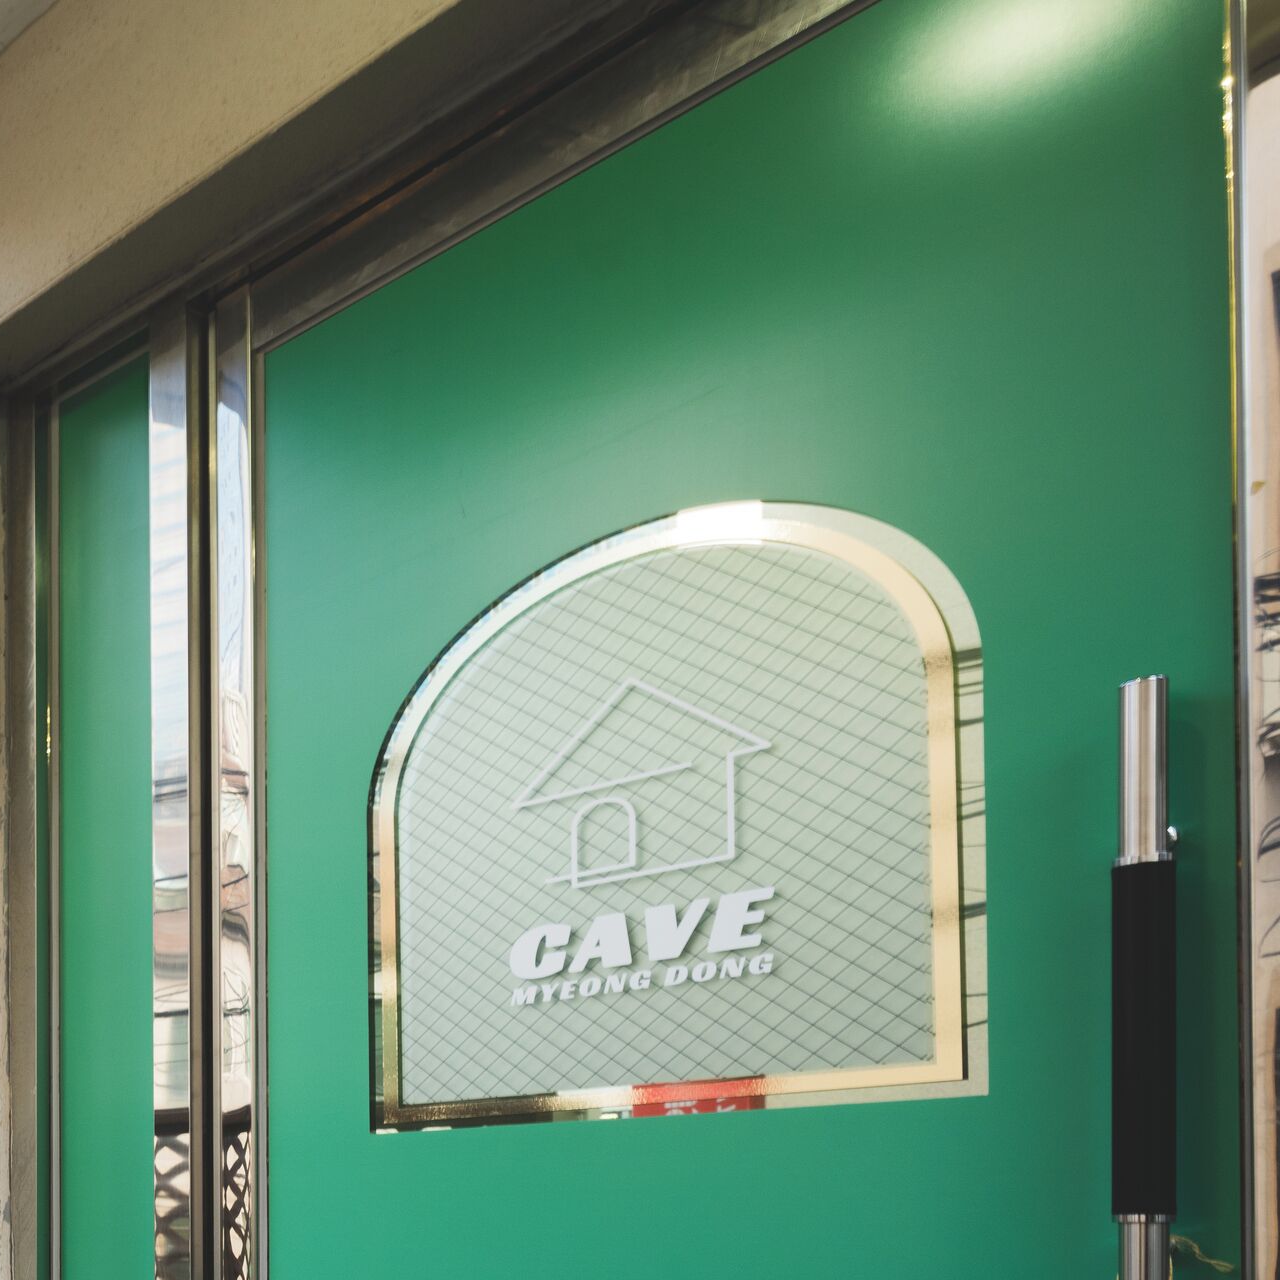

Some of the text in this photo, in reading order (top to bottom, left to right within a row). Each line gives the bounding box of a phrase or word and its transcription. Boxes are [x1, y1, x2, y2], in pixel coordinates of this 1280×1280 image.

[509, 886, 775, 980] CAVE
[510, 953, 774, 1006] MYEONG DONG
